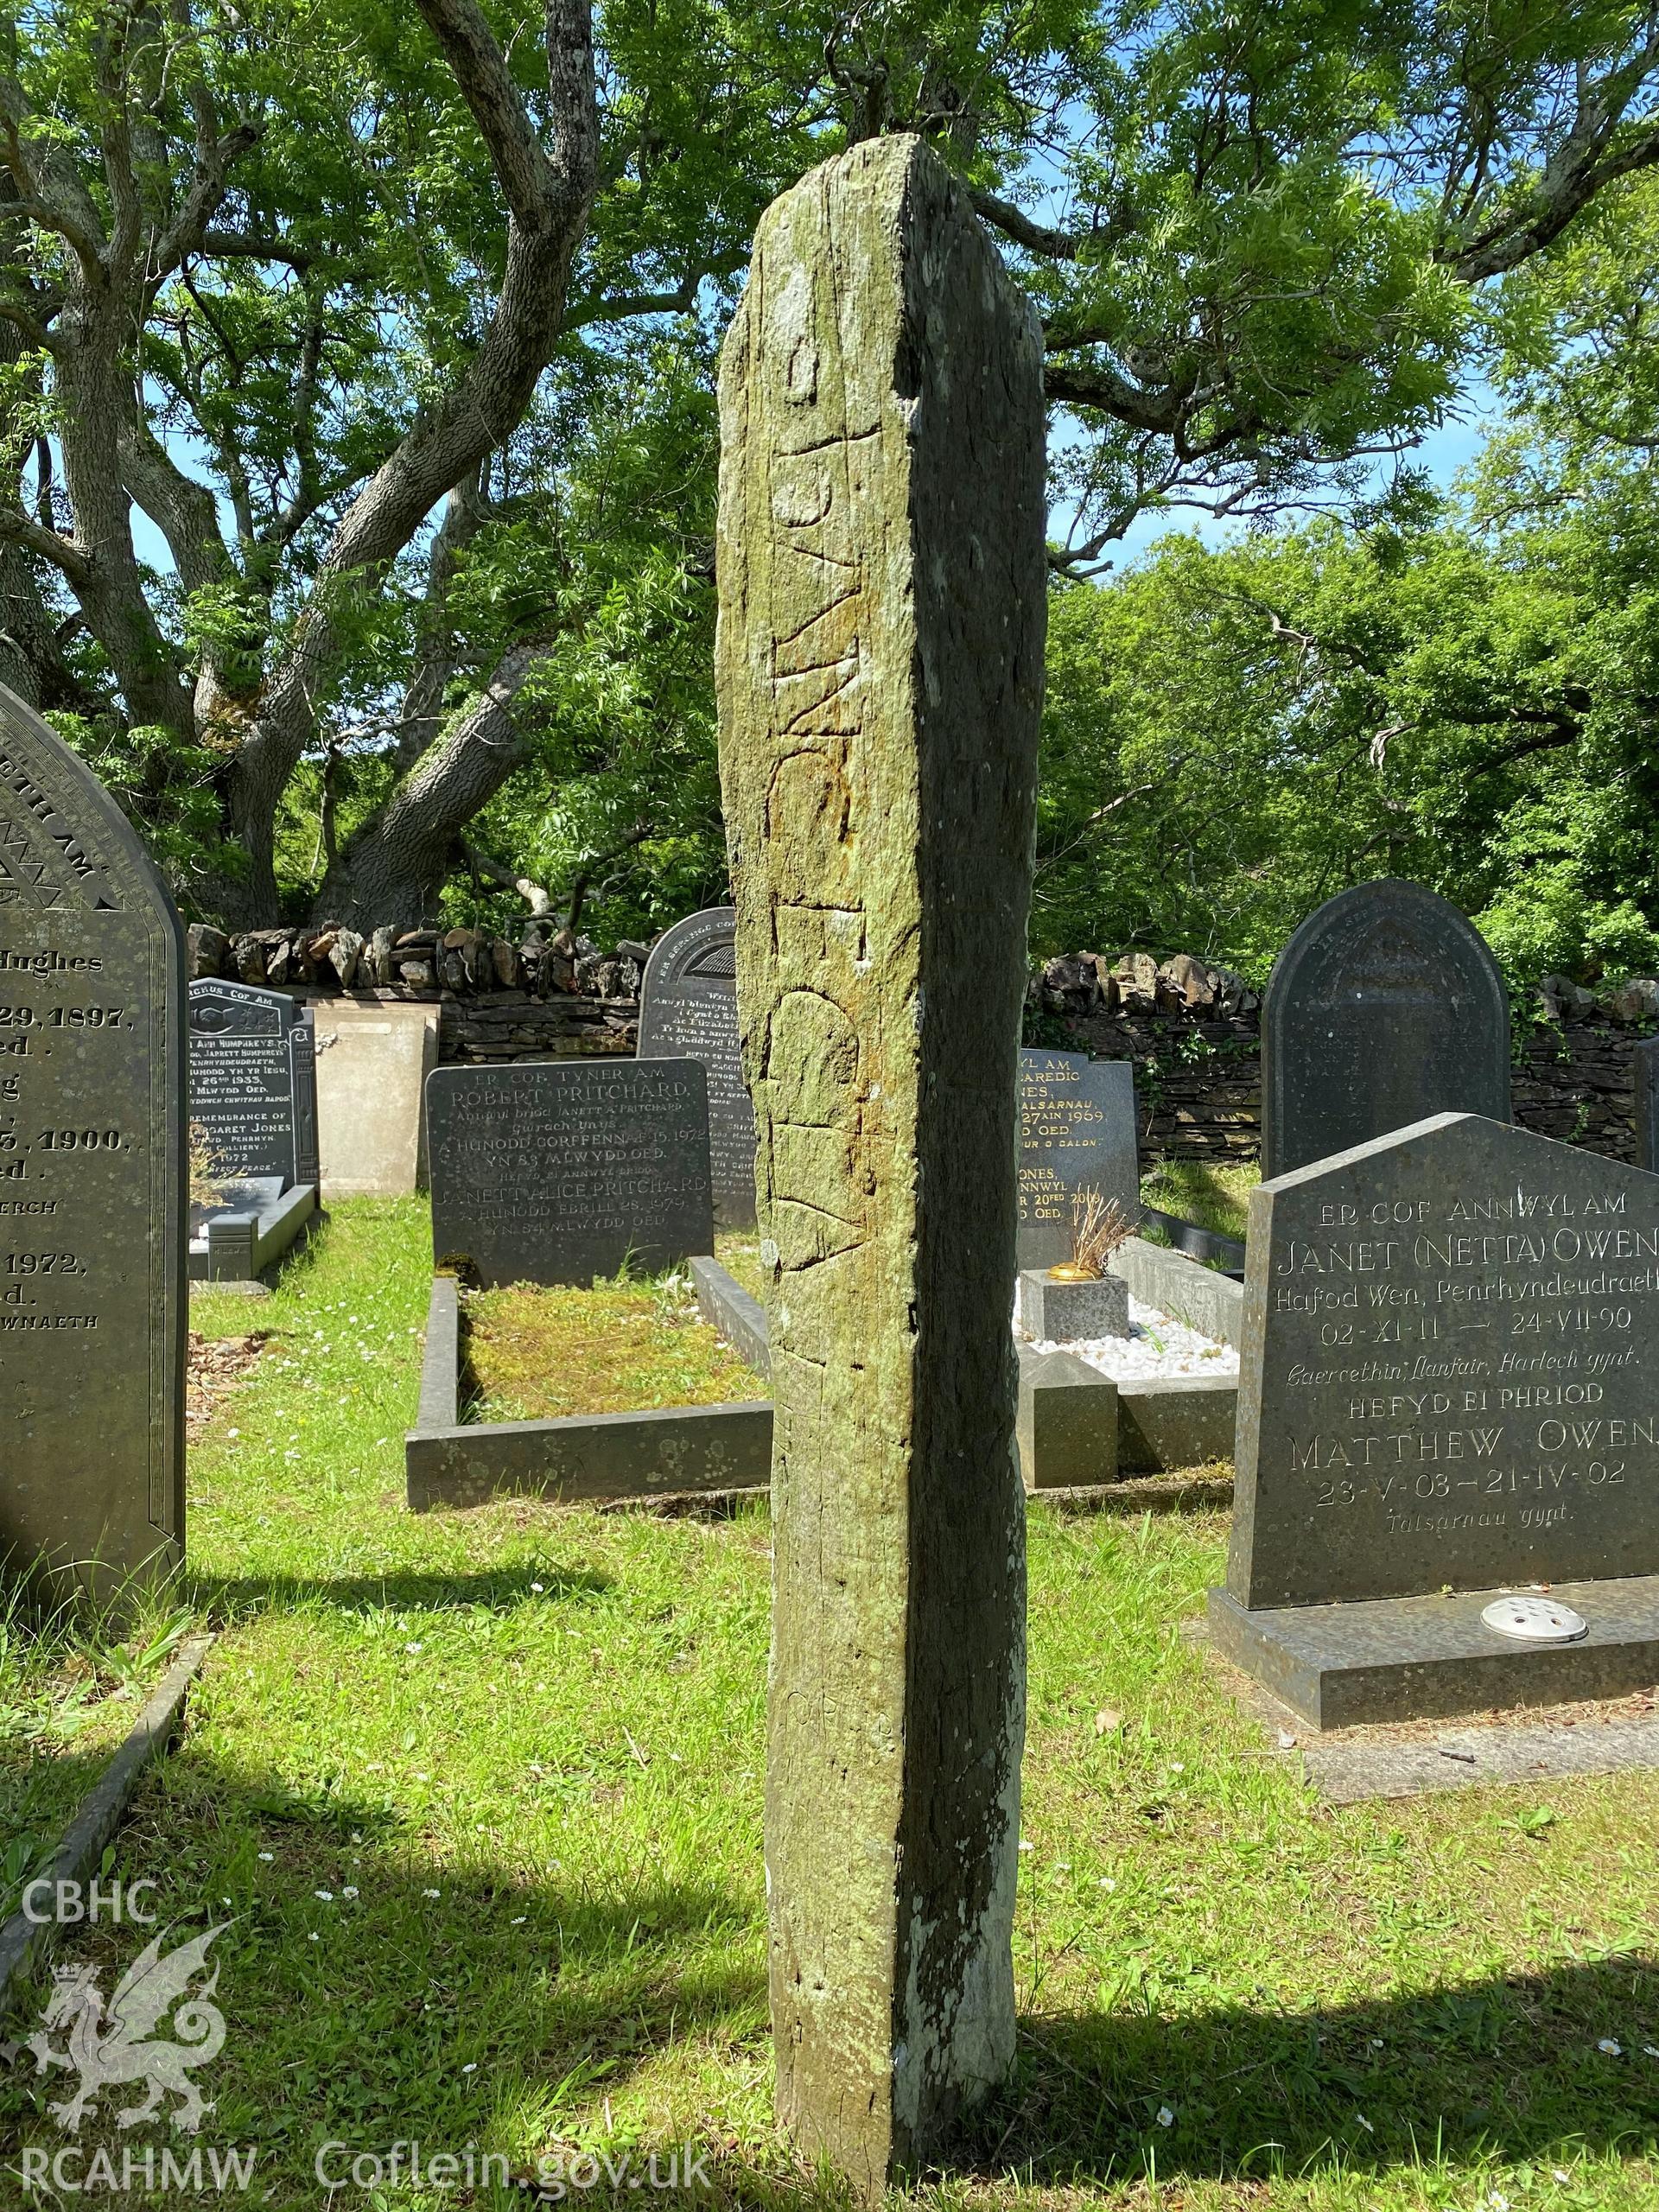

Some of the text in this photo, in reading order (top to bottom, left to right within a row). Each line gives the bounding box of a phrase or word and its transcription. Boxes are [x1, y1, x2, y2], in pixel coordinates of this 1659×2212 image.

[254, 995, 273, 1007] AM
[476, 1073, 499, 1086] ER
[556, 1068, 625, 1083] TYNER
[633, 1066, 666, 1081] AM
[1045, 1058, 1071, 1071] AM
[451, 1088, 543, 1107] ROBERT
[251, 1122, 292, 1133] JONES
[1319, 1192, 1627, 1227] ER COF ANNWYL AM
[1277, 1227, 1659, 1276] JANET (NETTA) OWEN
[1274, 1284, 1359, 1316] Hafod
[1364, 1283, 1427, 1308] Wen,
[1497, 1347, 1579, 1374] Harlech
[1584, 1344, 1641, 1376] gynt.
[1346, 1382, 1605, 1420] HEFYD EI PHRIOD
[1287, 1426, 1506, 1472] MATTHEW
[1386, 1510, 1506, 1535] Talsarnau
